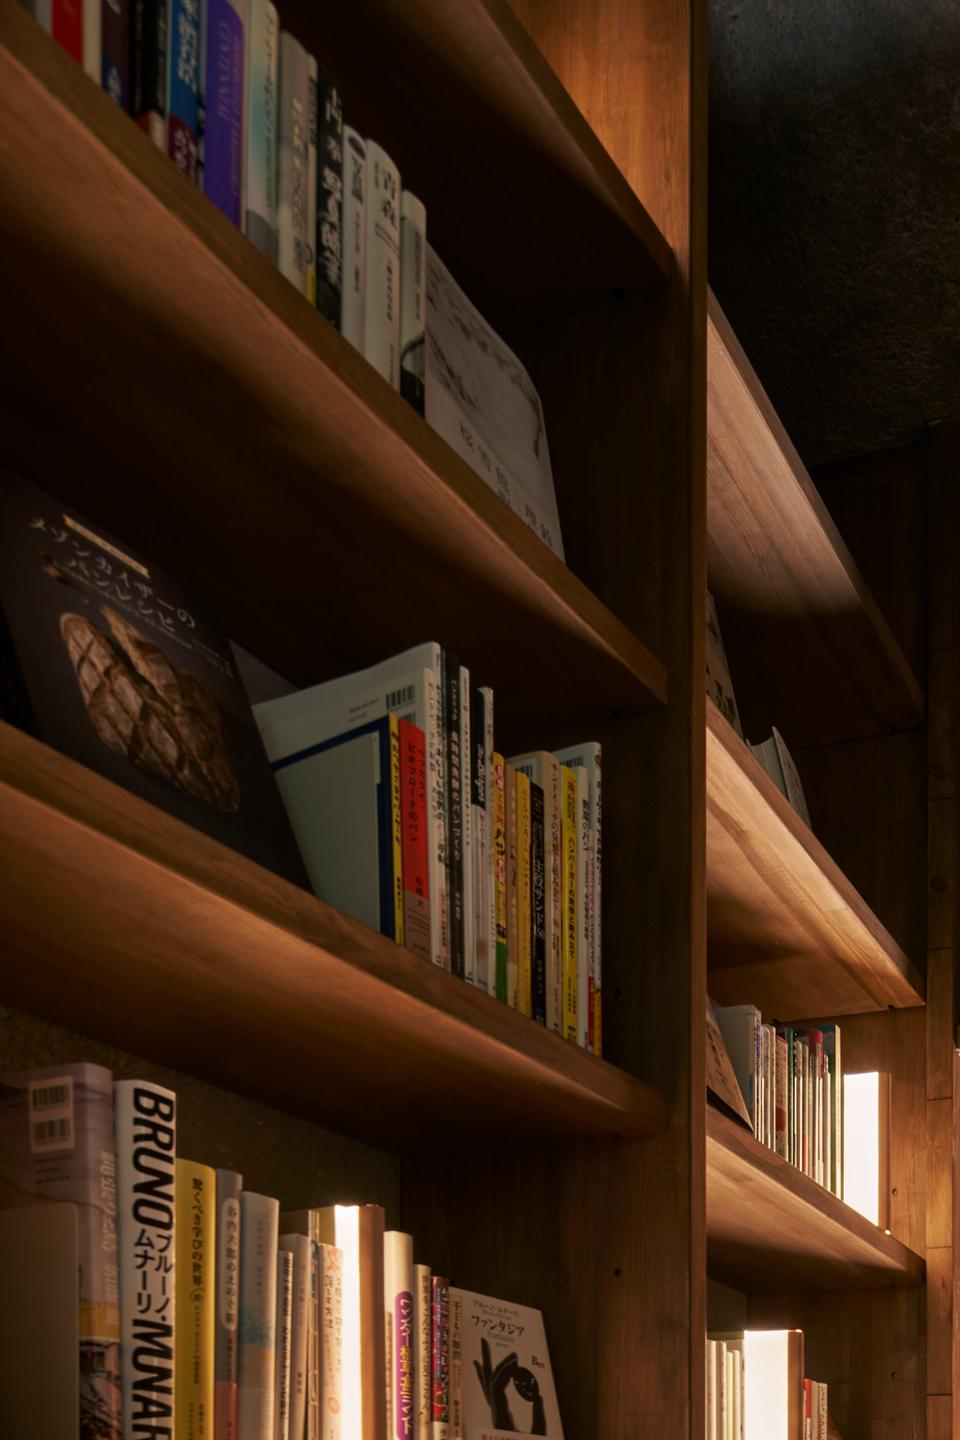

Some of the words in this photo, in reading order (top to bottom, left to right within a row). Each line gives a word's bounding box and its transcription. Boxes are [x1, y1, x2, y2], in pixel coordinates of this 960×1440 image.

[133, 1087, 173, 1231] BRUNO
[134, 1229, 154, 1315] ムナーリ
[471, 1315, 525, 1337] ファンタジア
